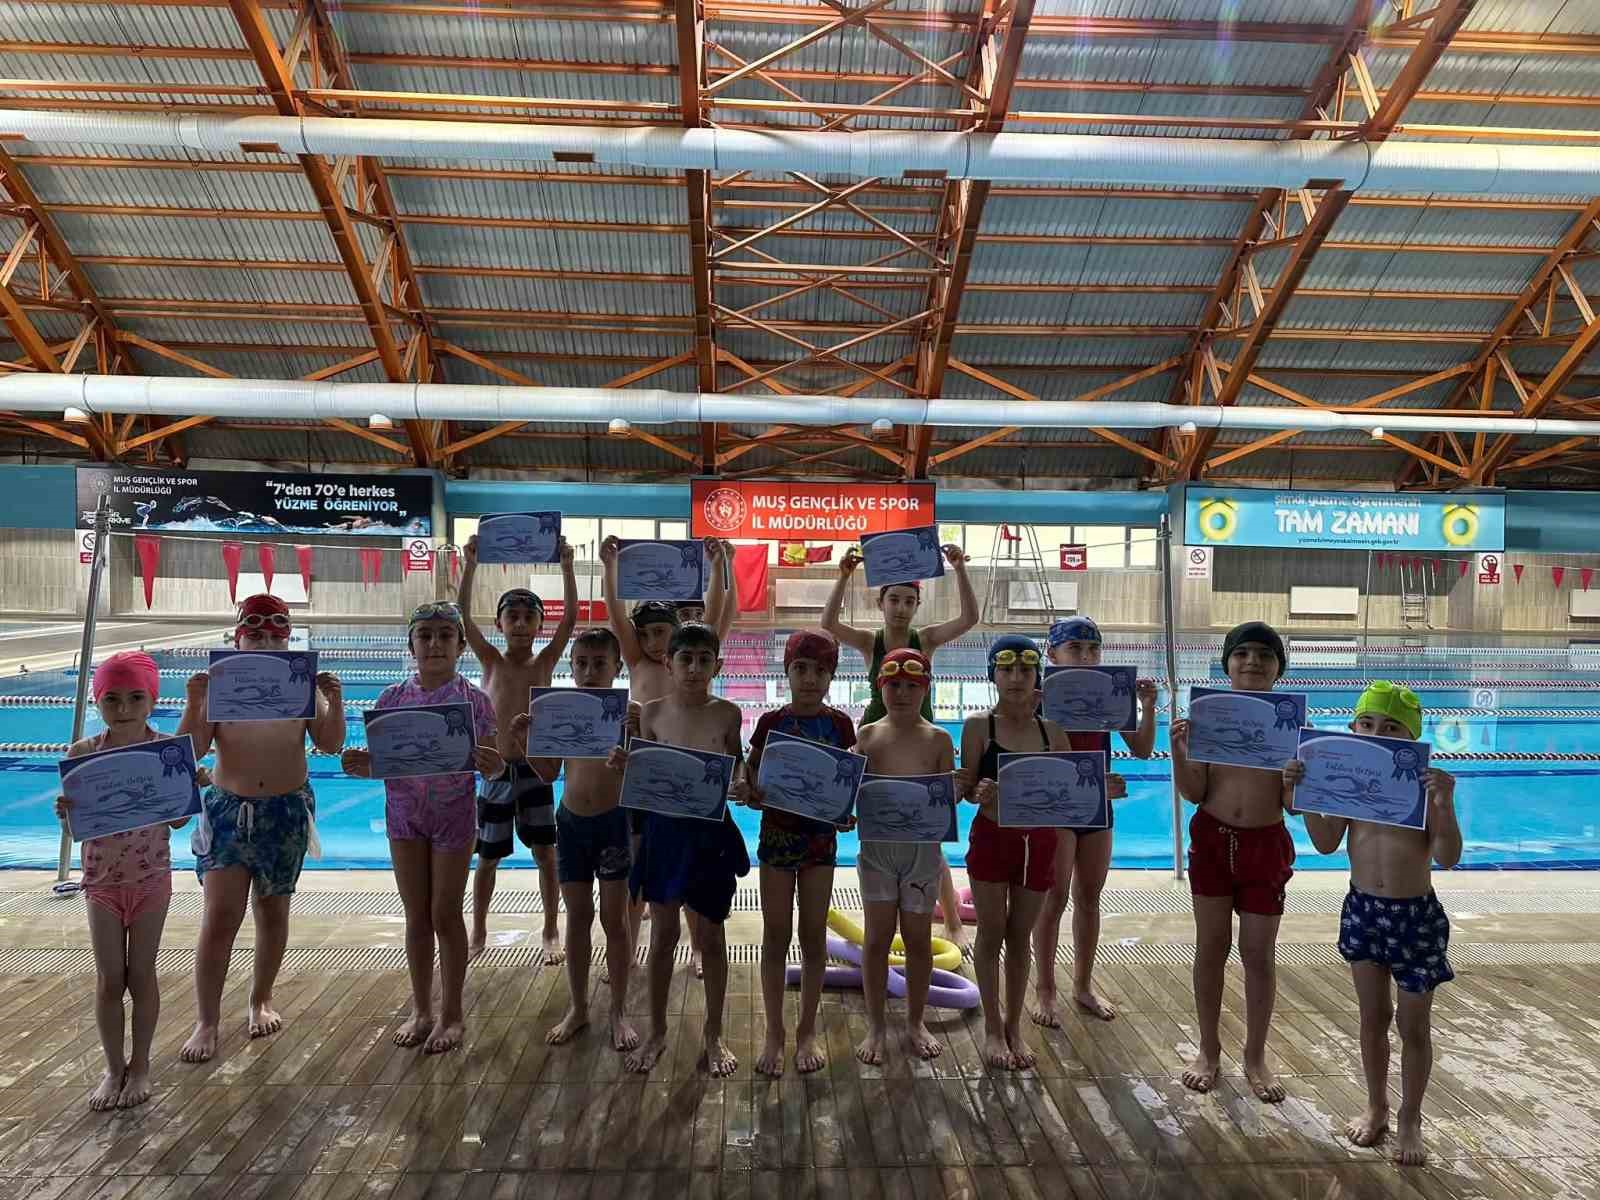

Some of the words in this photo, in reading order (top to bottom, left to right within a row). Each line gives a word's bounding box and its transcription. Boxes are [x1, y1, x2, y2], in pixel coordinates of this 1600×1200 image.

[113, 476, 131, 484] MUŞ
[132, 476, 165, 485] GENÇLİK
[176, 478, 198, 486] SPOR
[123, 486, 172, 495] MÜDÜRLÜĞÜ
[350, 485, 395, 497] herkes
[275, 497, 318, 510] YÜZME
[752, 495, 786, 511] MUŞ
[790, 494, 854, 512] GENÇLİK
[858, 497, 876, 509] VE
[880, 497, 919, 511] SPOR
[752, 515, 765, 529] İL
[768, 513, 868, 530] MÜDÜRLÜĞÜ
[1274, 509, 1323, 534] TAM
[1330, 511, 1419, 536] ZAMANI
